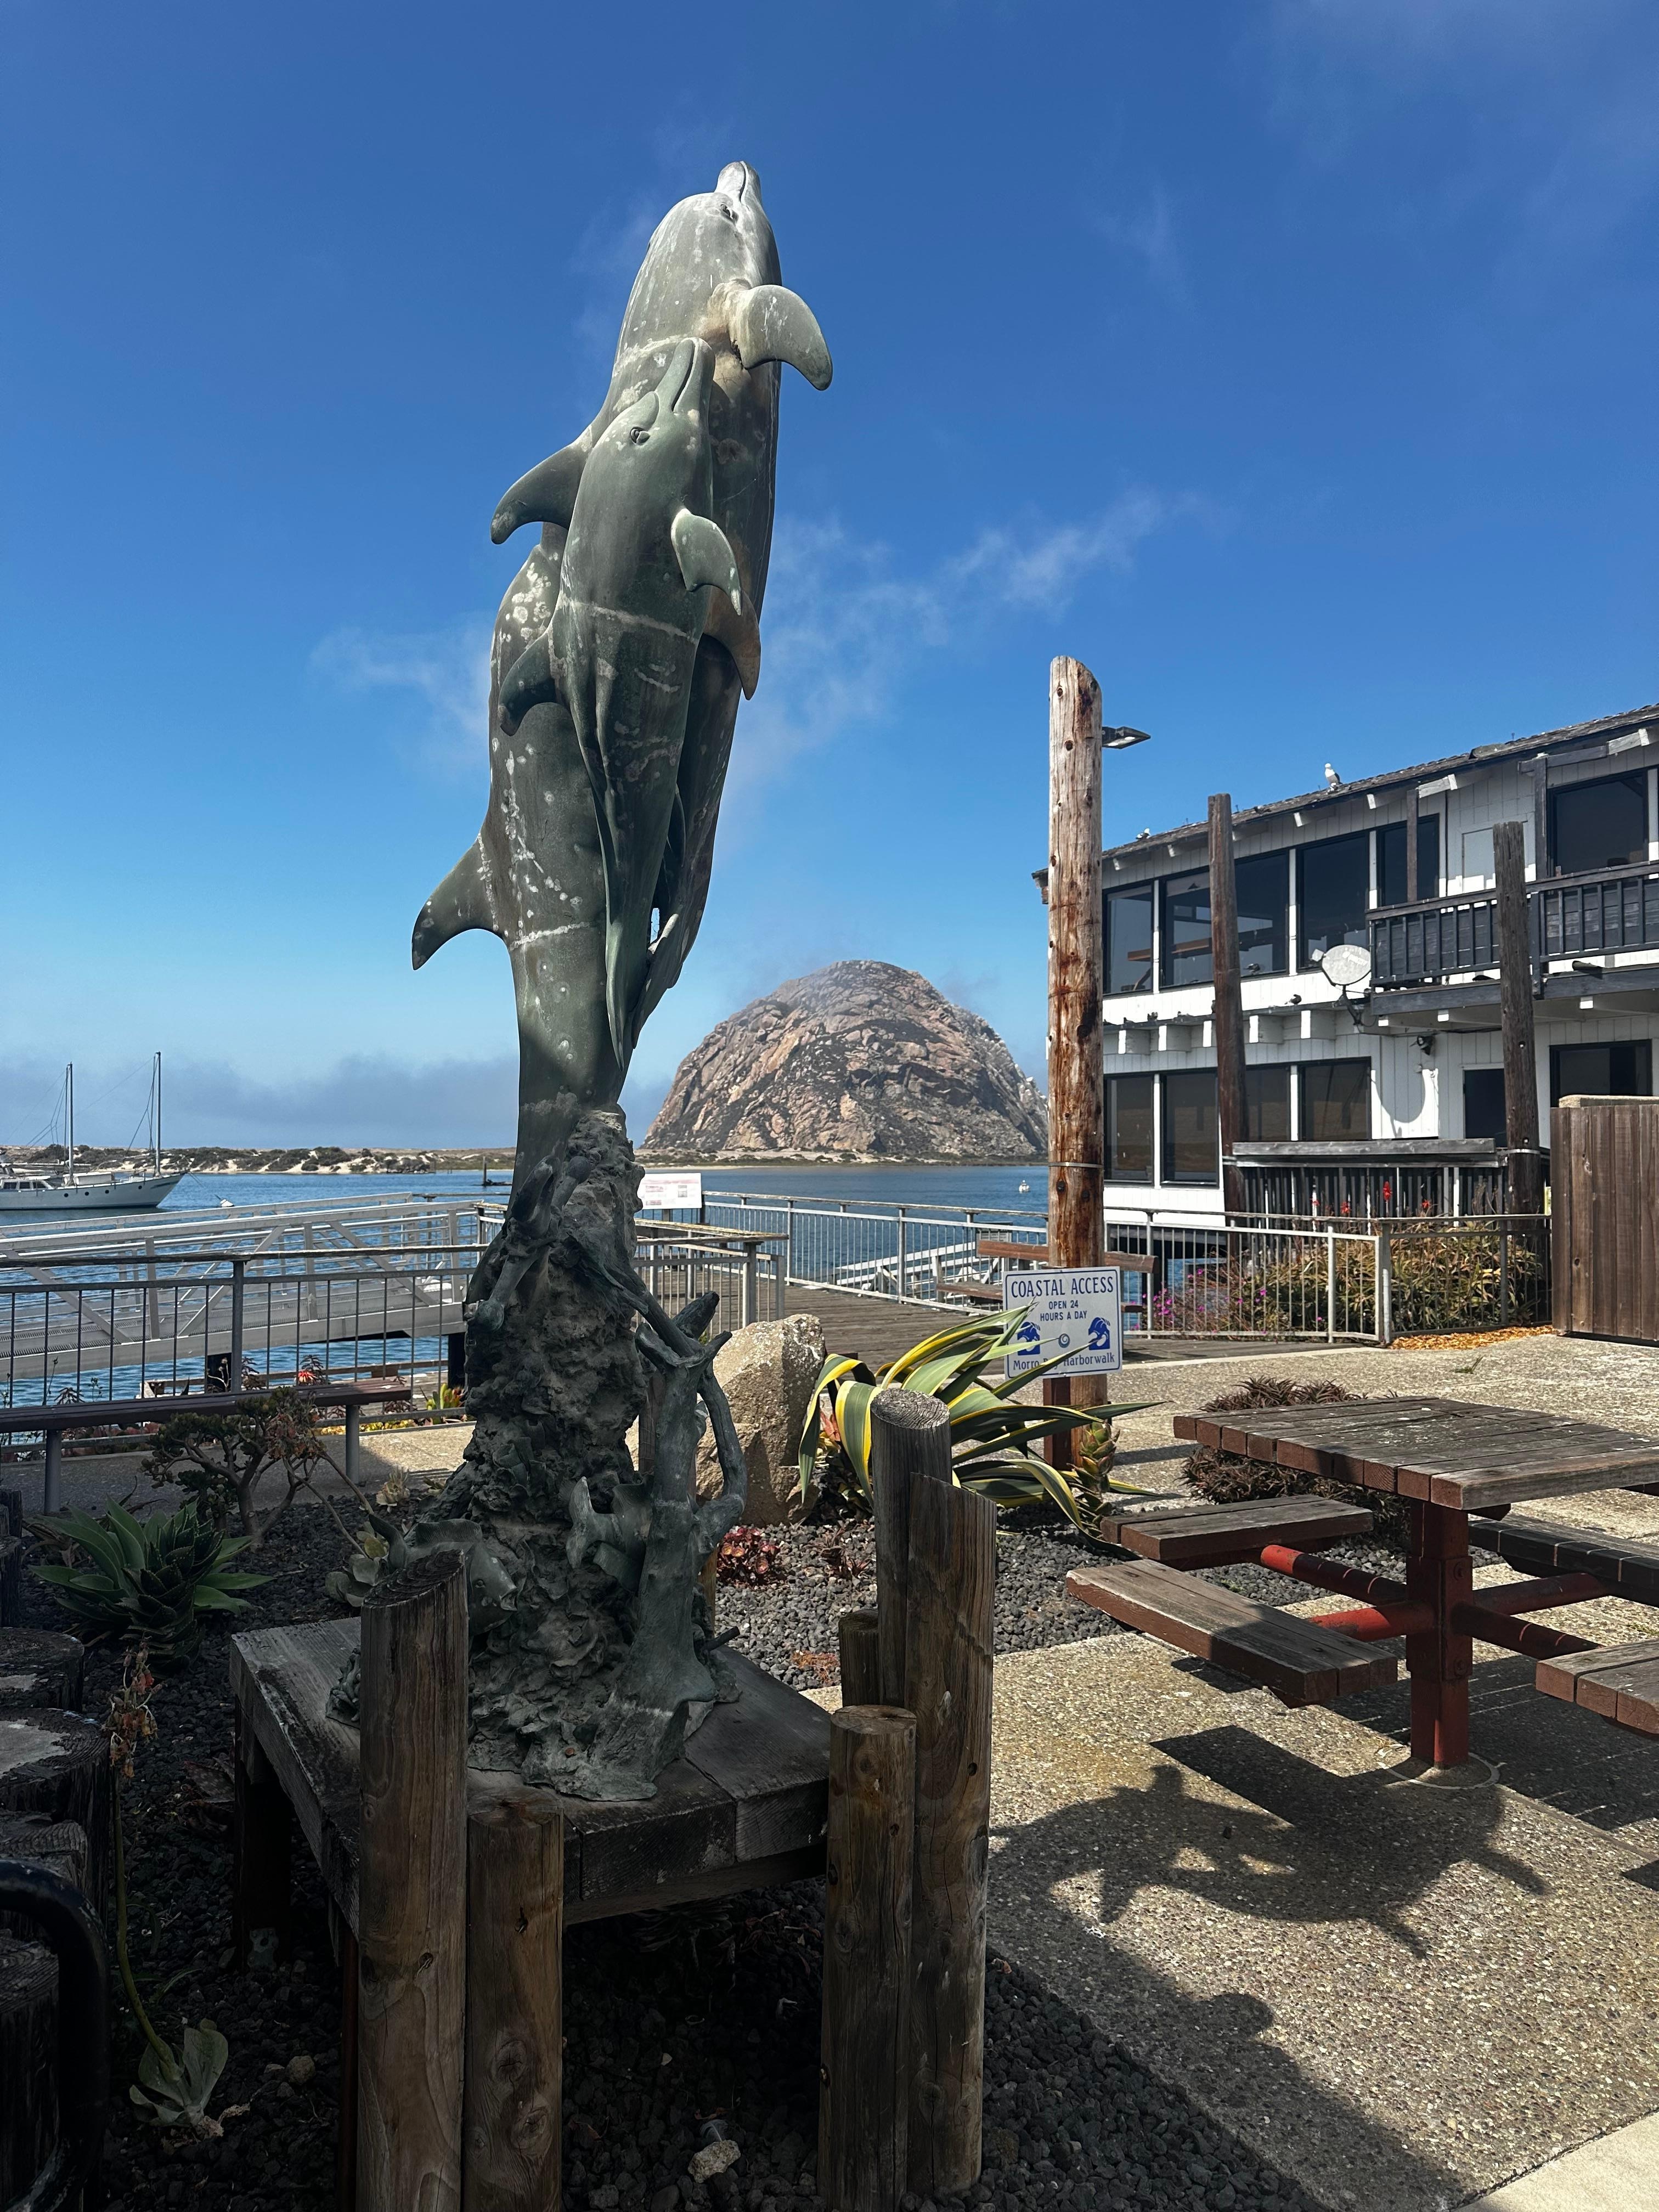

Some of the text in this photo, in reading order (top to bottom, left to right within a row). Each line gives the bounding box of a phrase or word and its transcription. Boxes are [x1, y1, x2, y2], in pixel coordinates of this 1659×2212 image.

[1011, 1276, 1113, 1298] COASTAL ACCESS
[1048, 1300, 1079, 1310] OPEN 24
[1040, 1312, 1063, 1321] HOURS
[1074, 1310, 1087, 1319] DAY
[1013, 1360, 1040, 1370] Morro
